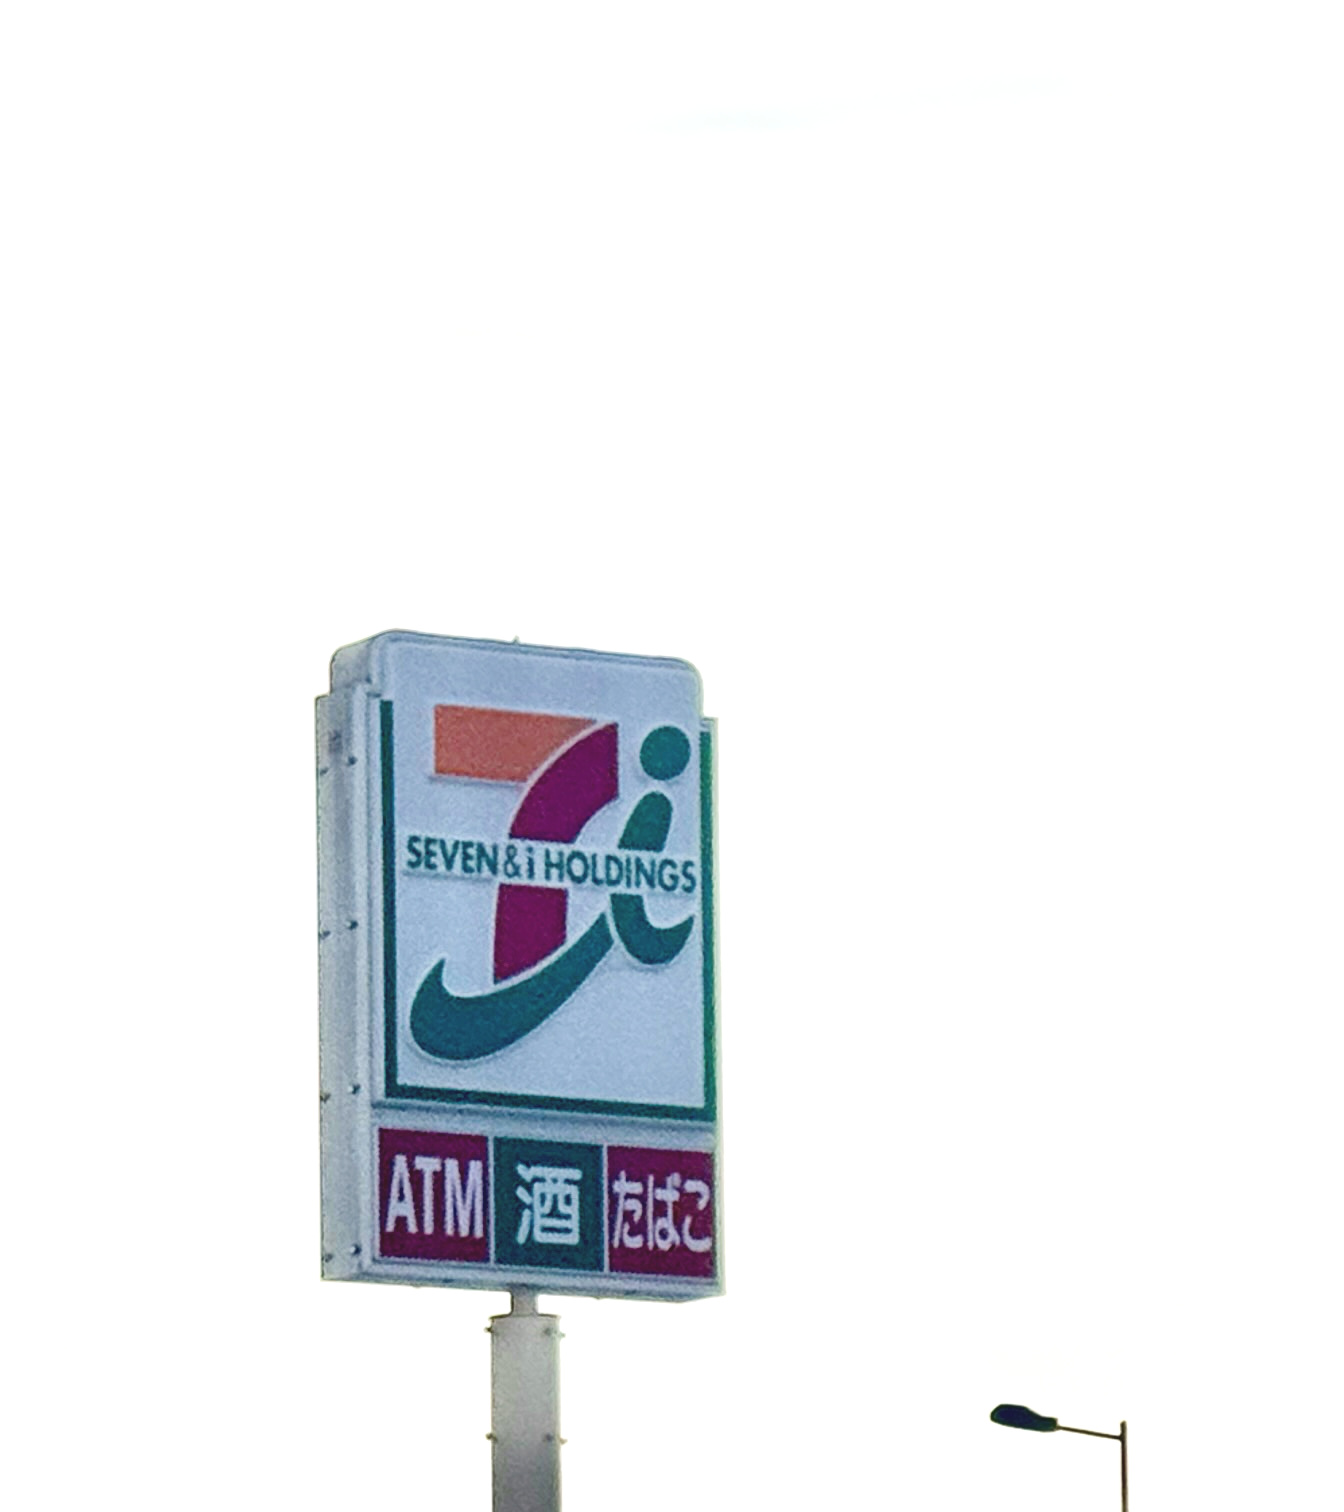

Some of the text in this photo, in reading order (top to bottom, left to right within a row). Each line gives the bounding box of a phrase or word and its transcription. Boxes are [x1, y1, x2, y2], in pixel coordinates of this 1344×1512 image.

[544, 848, 697, 893] HOLDINGS
[385, 1153, 484, 1239] ATM
[515, 1163, 583, 1245] 酒
[613, 1170, 712, 1252] たばこ
